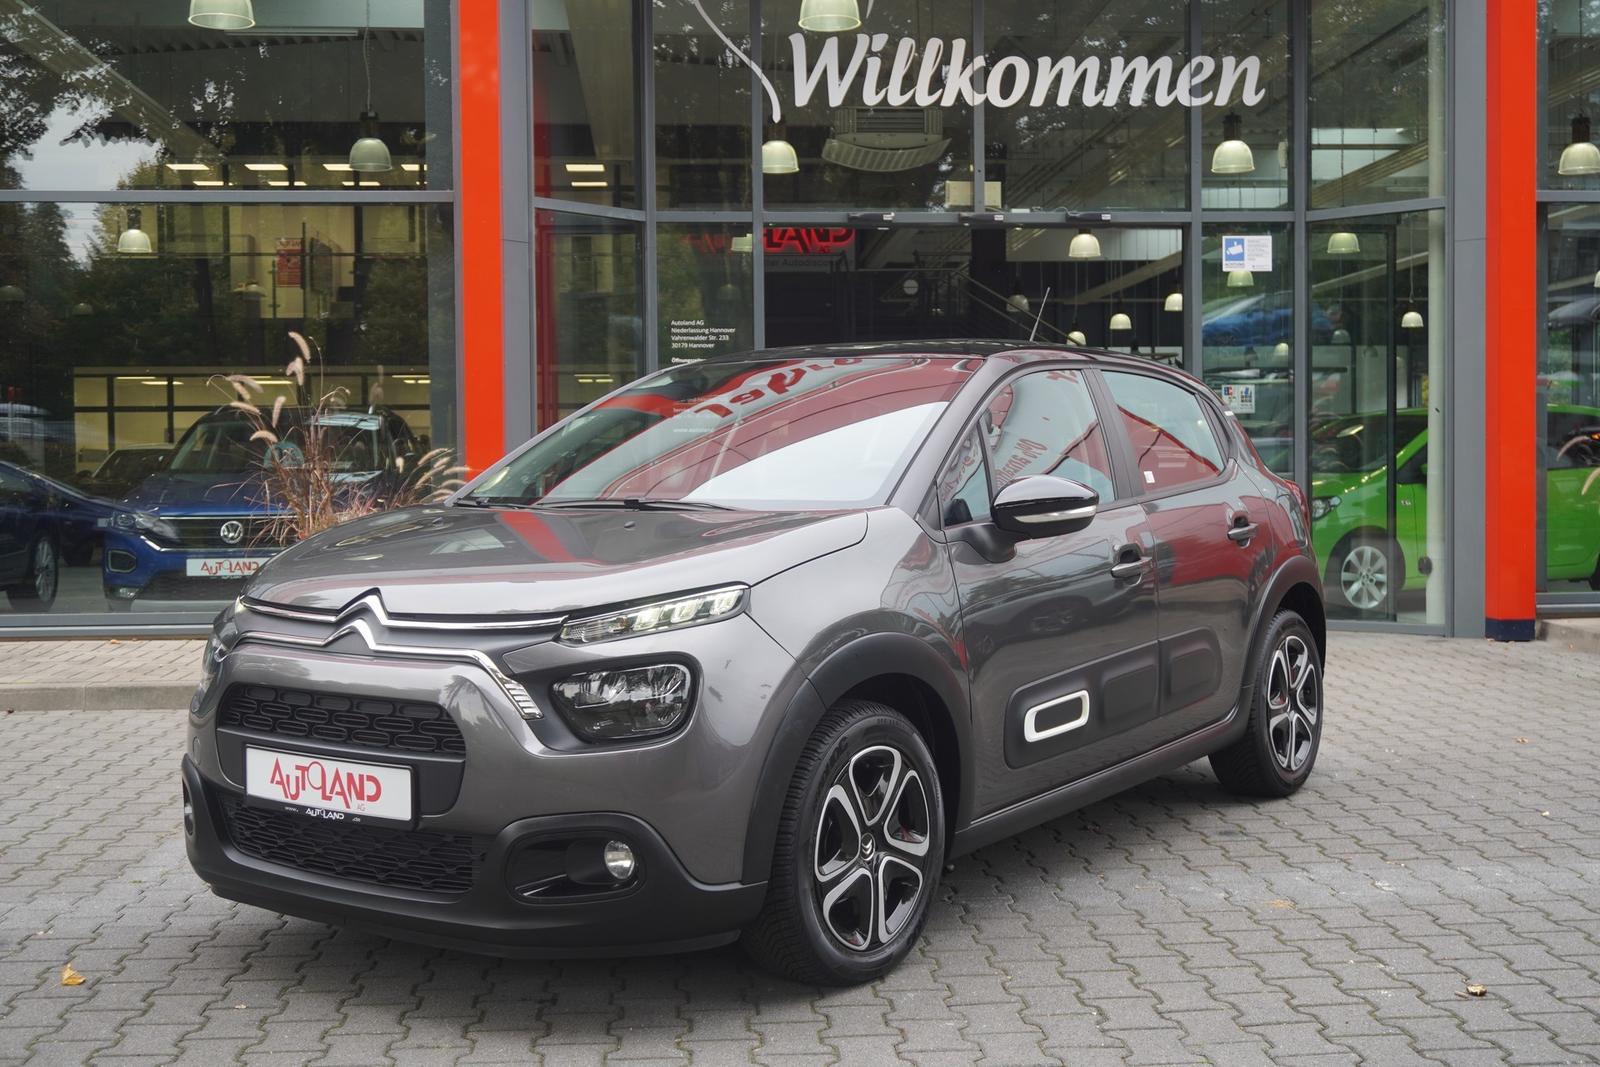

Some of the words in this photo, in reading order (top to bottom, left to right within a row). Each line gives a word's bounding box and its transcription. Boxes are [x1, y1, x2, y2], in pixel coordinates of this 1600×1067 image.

[788, 32, 1266, 107] Willkommen
[270, 757, 382, 809] AUTOLAND
[305, 808, 345, 820] AUTOLAND
